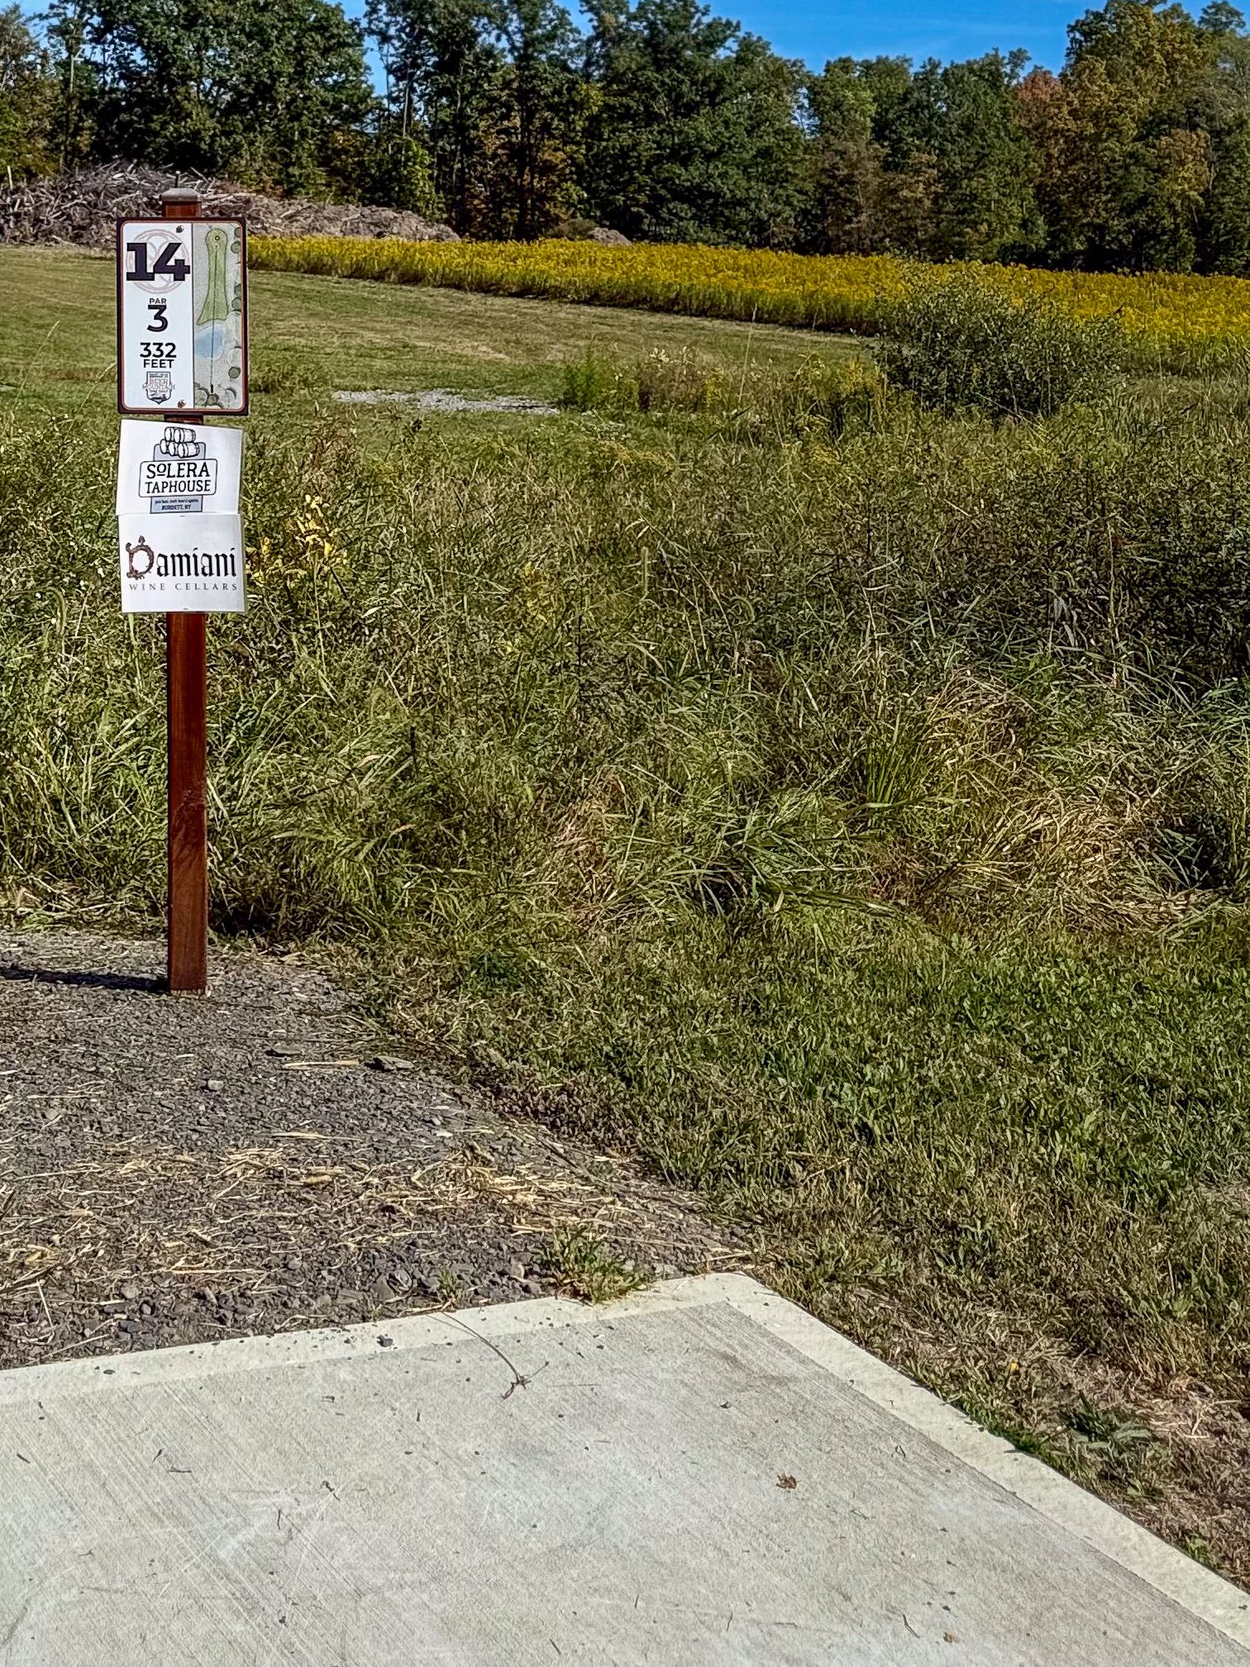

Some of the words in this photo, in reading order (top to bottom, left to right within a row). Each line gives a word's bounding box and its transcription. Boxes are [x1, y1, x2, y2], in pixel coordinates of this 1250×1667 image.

[126, 242, 190, 281] 14
[149, 297, 167, 305] PAR
[147, 304, 168, 332] 3
[139, 342, 176, 358] 332
[143, 359, 175, 369] FEET
[145, 480, 211, 494] TAPHOUSE
[125, 535, 236, 581] Damiani
[129, 583, 166, 591] WINE
[175, 583, 237, 591] CELLARS
